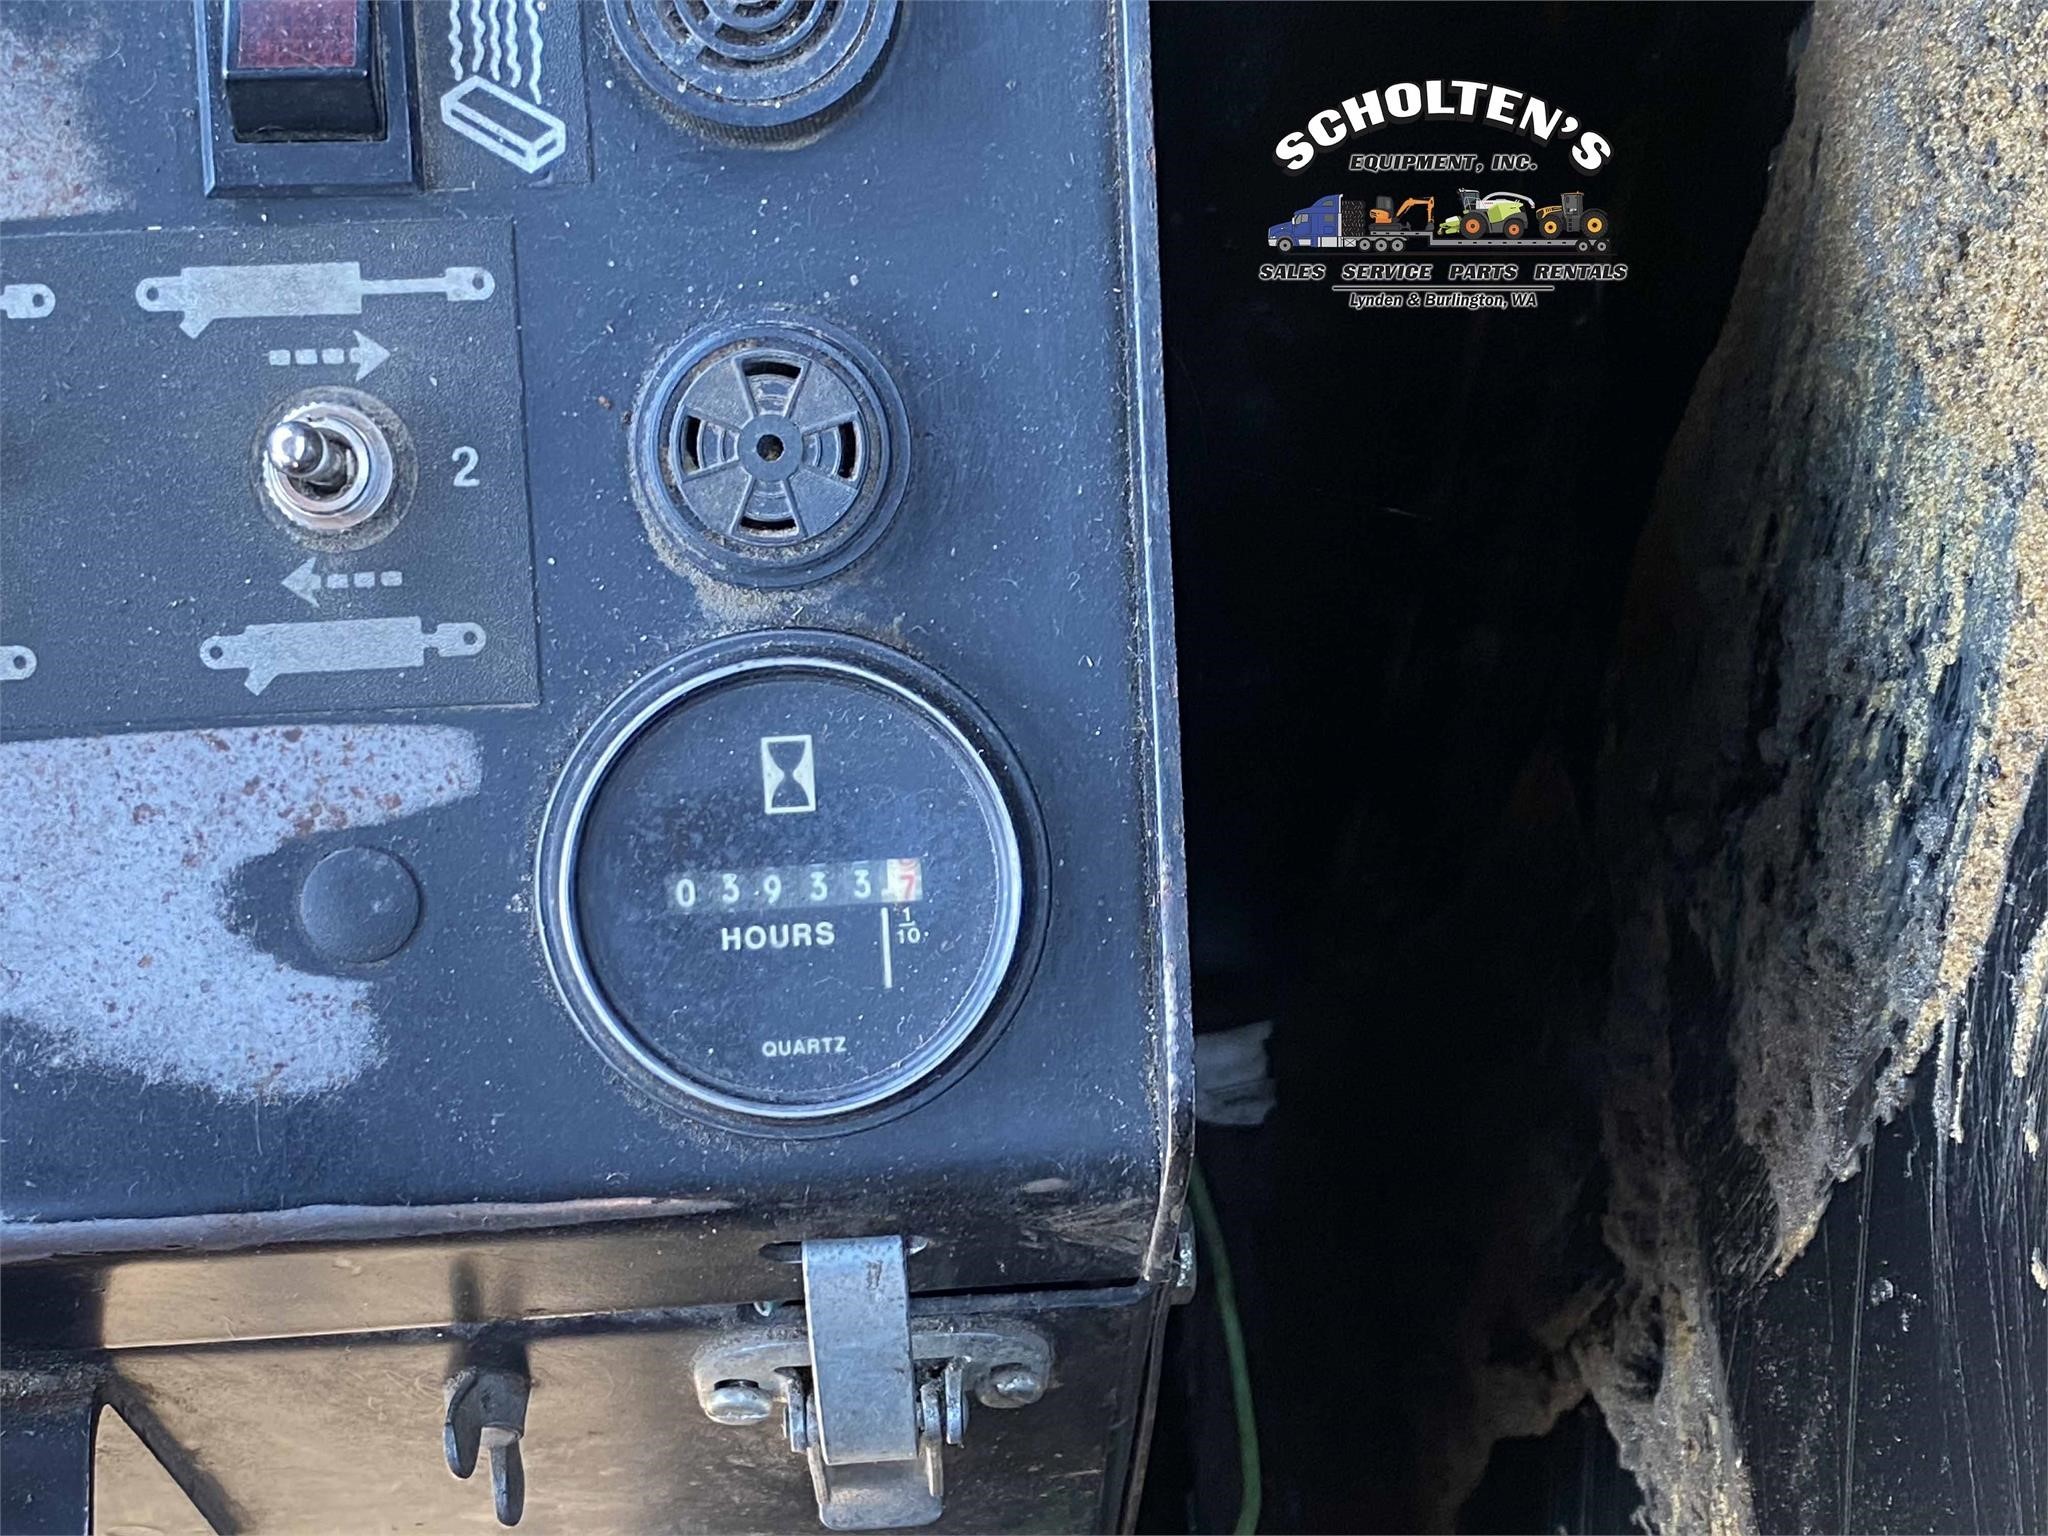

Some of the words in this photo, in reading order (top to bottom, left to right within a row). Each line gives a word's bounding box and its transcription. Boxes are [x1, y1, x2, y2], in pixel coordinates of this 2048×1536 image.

[451, 445, 481, 488] 2
[721, 922, 835, 951] HOURS
[761, 1035, 848, 1057] QUARTZ
